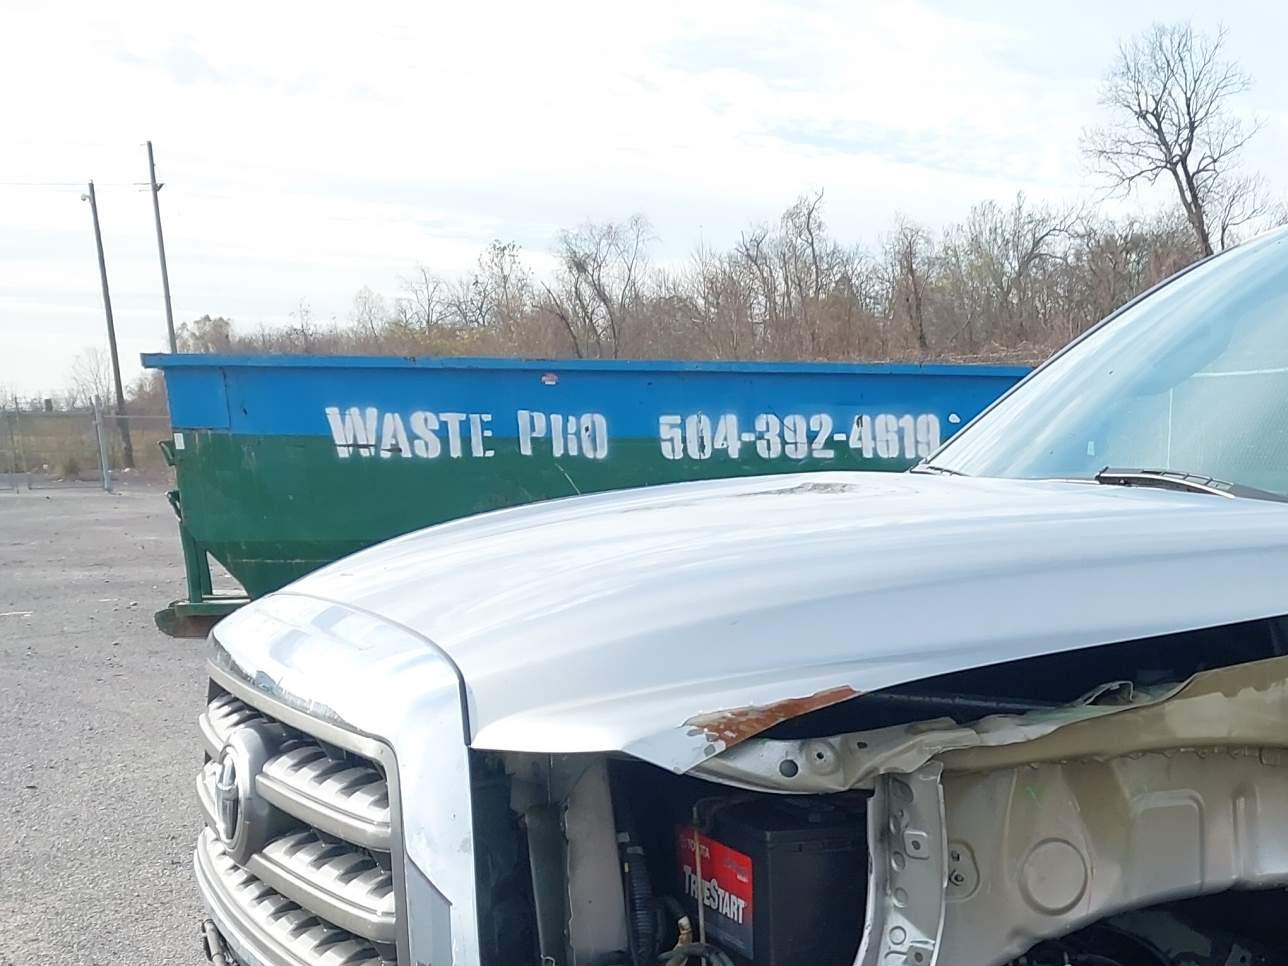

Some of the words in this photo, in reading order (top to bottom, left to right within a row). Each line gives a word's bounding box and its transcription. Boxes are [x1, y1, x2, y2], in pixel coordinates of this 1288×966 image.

[324, 406, 496, 459] WASTE
[517, 409, 609, 460] PRO
[658, 412, 941, 460] 504-392-4619
[682, 864, 746, 925] TRESTART
